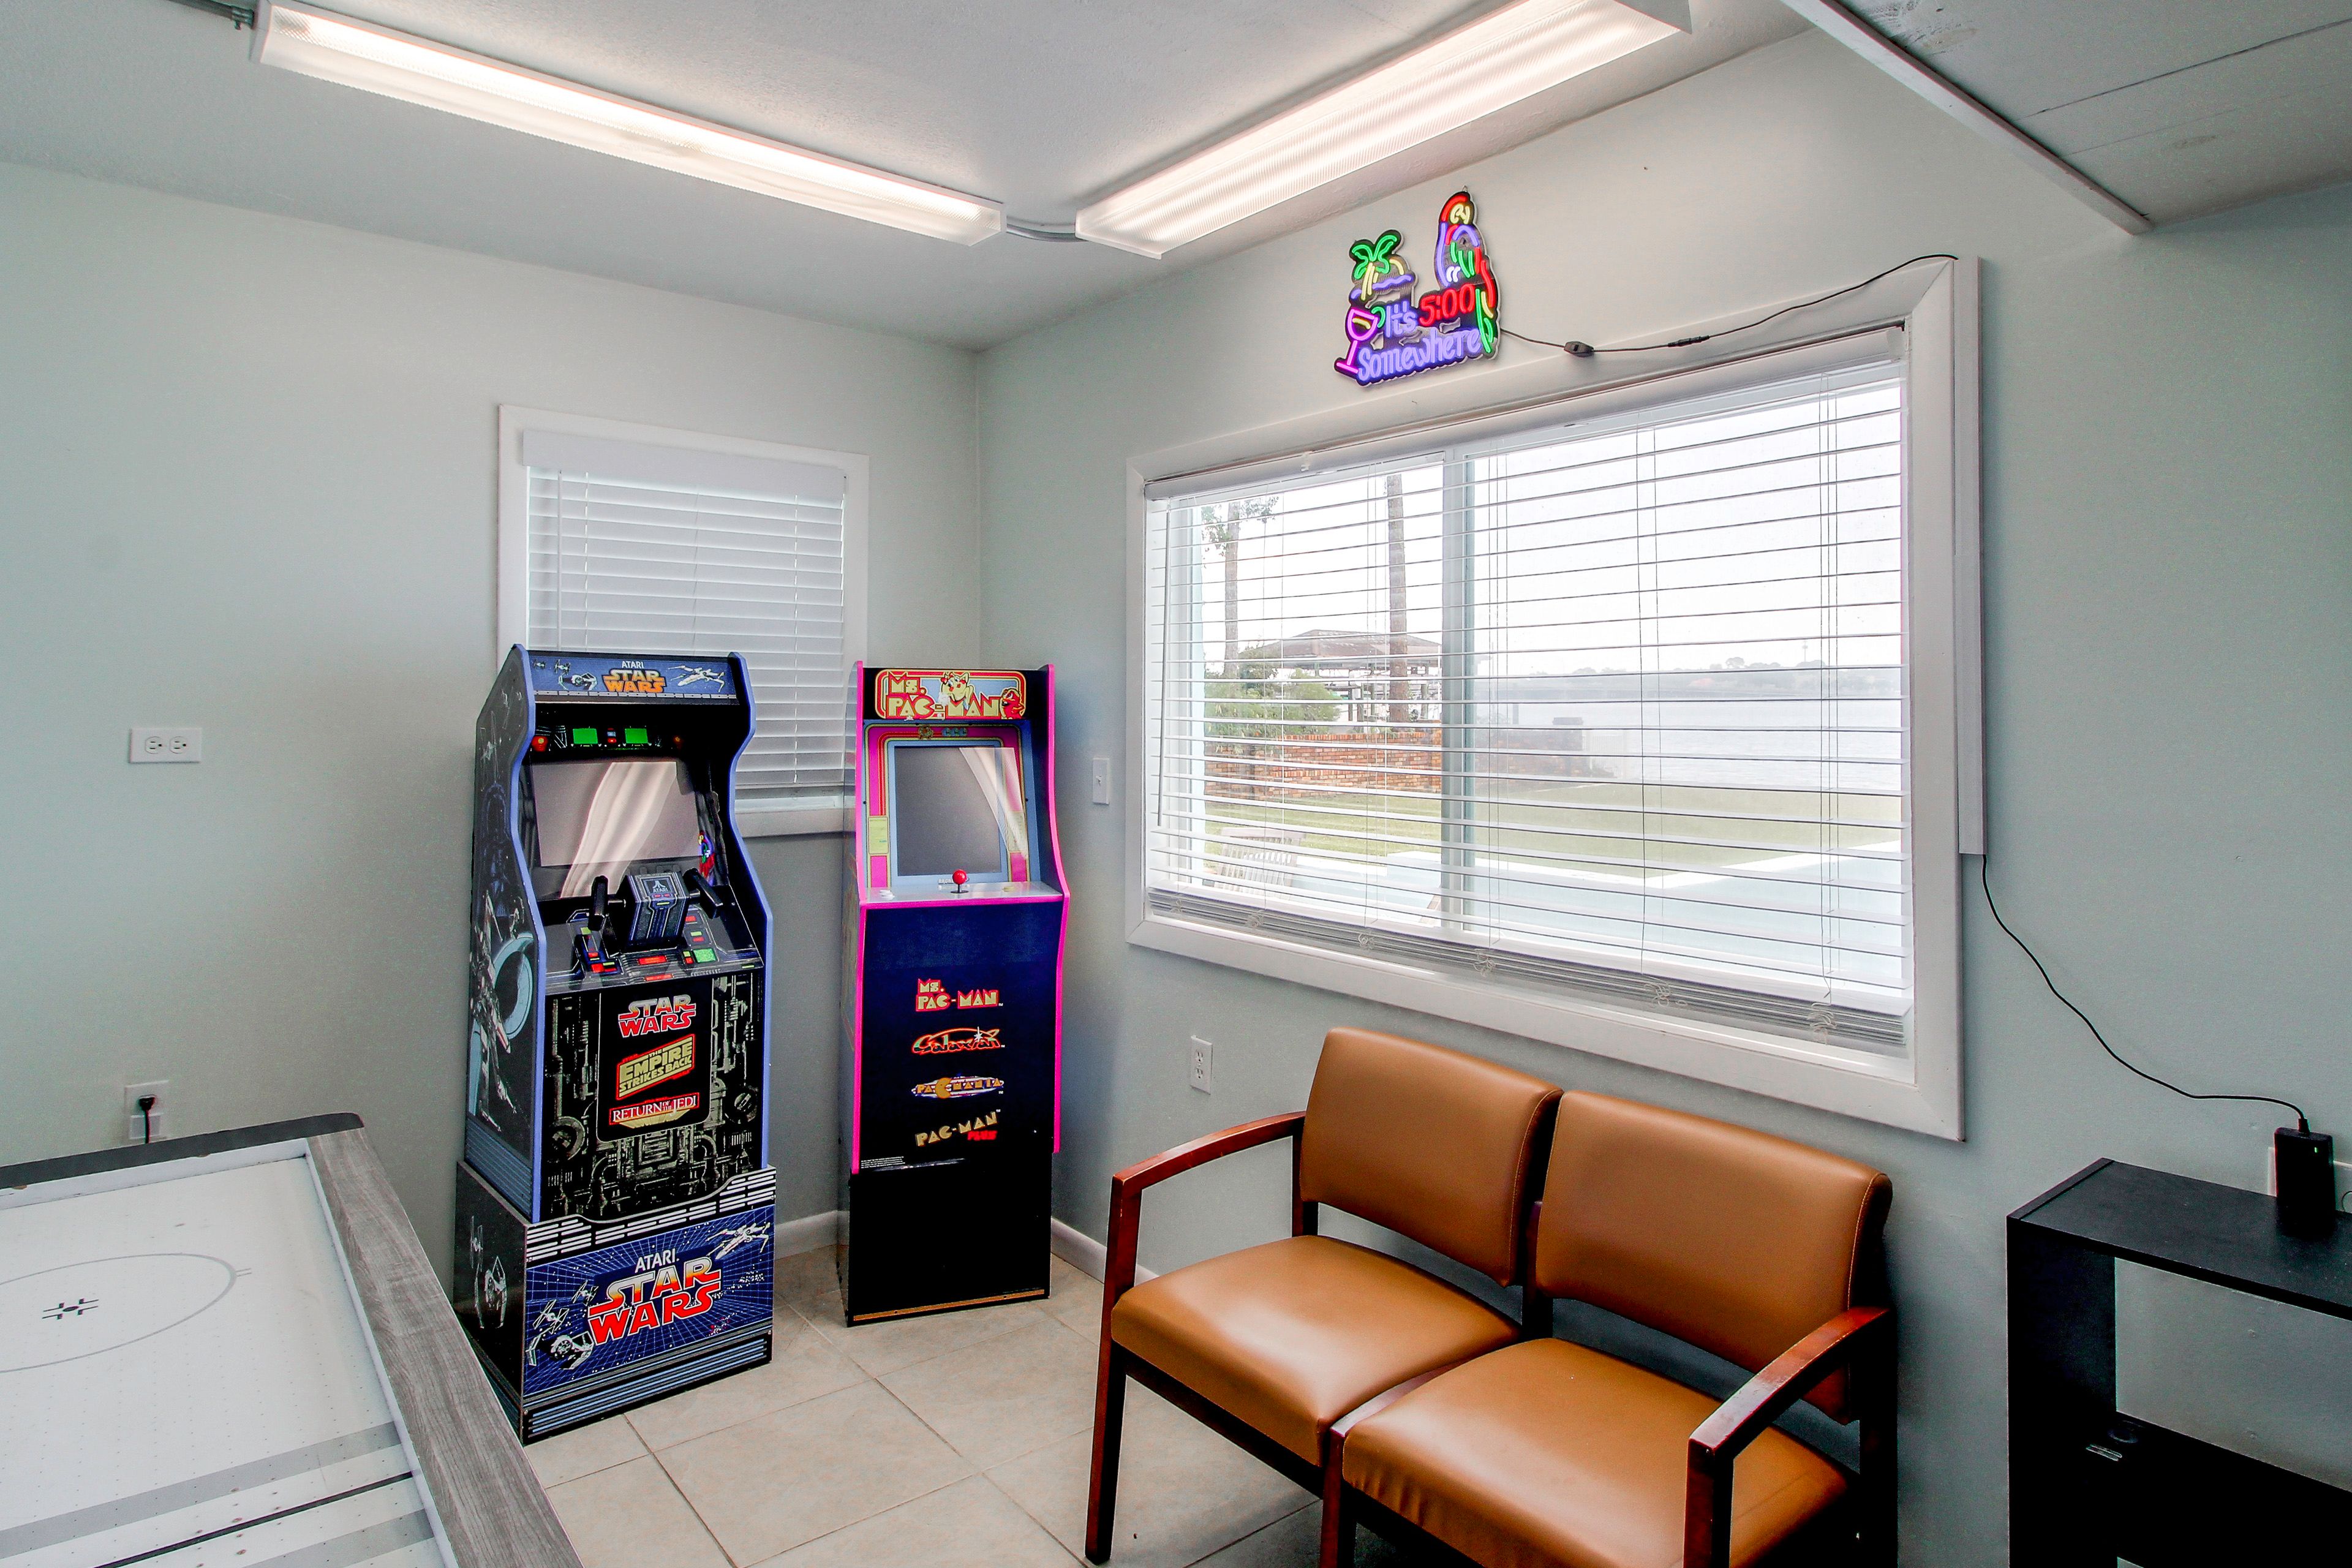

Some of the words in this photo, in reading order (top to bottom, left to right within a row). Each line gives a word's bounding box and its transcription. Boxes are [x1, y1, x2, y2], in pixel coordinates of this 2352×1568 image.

[1385, 301, 1417, 337] It's
[1419, 283, 1476, 326] 5:00
[1358, 328, 1482, 381] Somewhere
[603, 669, 665, 681] STAR
[622, 660, 644, 669] ATARI
[603, 680, 665, 693] WARS
[618, 994, 696, 1020] STAR
[916, 990, 999, 1011] PAC-MAN
[618, 1011, 696, 1038] WARS
[619, 1041, 693, 1083] EMPIRE
[649, 1049, 663, 1058] THE
[619, 1066, 665, 1091] STRIKES
[665, 1055, 692, 1074] BACK
[613, 1101, 663, 1122] RETURN
[669, 1095, 696, 1117] JEDI
[915, 1111, 998, 1147] PAC-MAN
[588, 1256, 722, 1318] STAR
[588, 1281, 722, 1346] WARS
